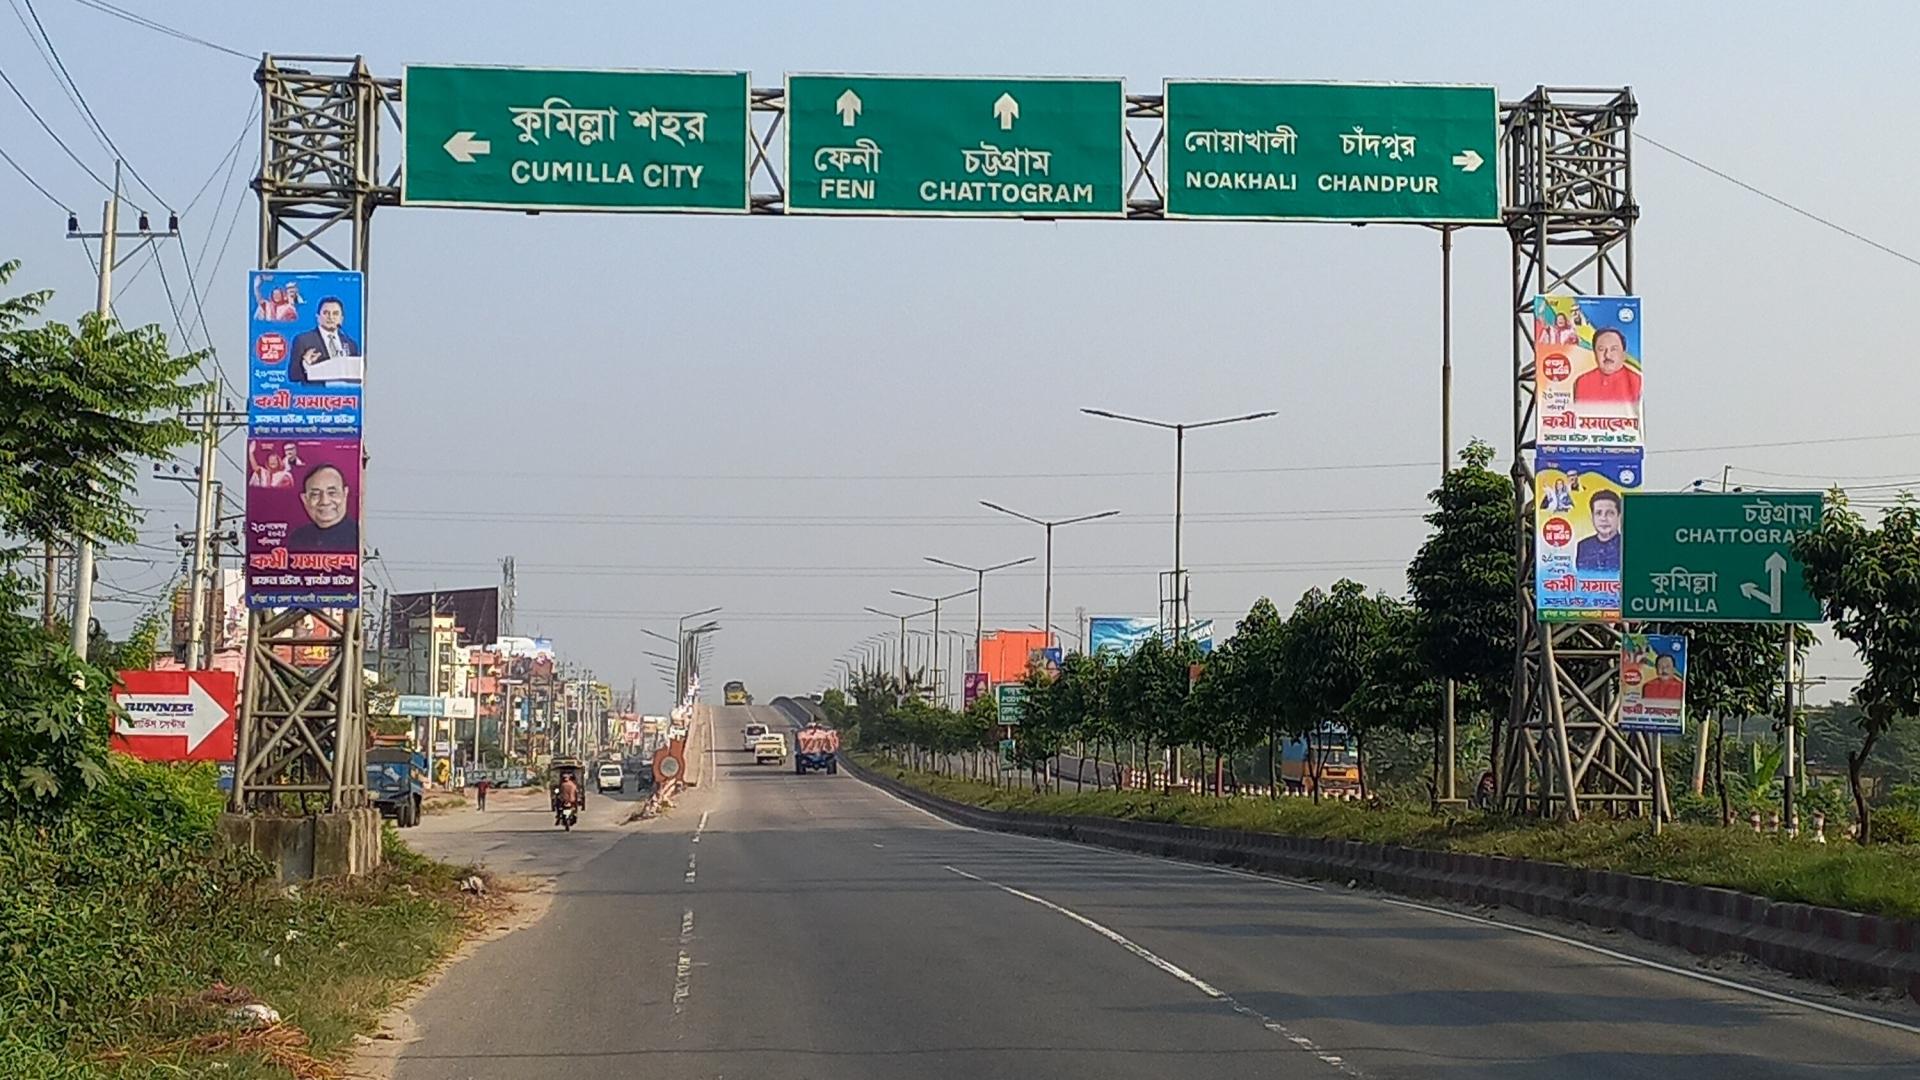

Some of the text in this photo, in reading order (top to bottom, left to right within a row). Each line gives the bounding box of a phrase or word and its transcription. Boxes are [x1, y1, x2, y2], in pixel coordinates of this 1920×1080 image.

[508, 96, 708, 147] কুমিল্লা শহর
[814, 137, 882, 174] ফেনী
[1185, 125, 1417, 162] নোয়াখালী চাঁদপুর
[961, 141, 1052, 177] চট্টগ্রাম
[511, 160, 704, 189] CUMILLA CITY
[1185, 171, 1440, 194] NOAKHALI CHANDPUR
[820, 178, 875, 200] FENI
[919, 180, 1093, 204] CHATTOGRAM
[1742, 498, 1813, 525] চট্টগ্রাম
[1675, 528, 1812, 544] CHATTOGRA
[1649, 567, 1718, 596] কুমিল্লা
[1631, 597, 1718, 613] CUMILLA
[125, 702, 194, 712] RUNNER
